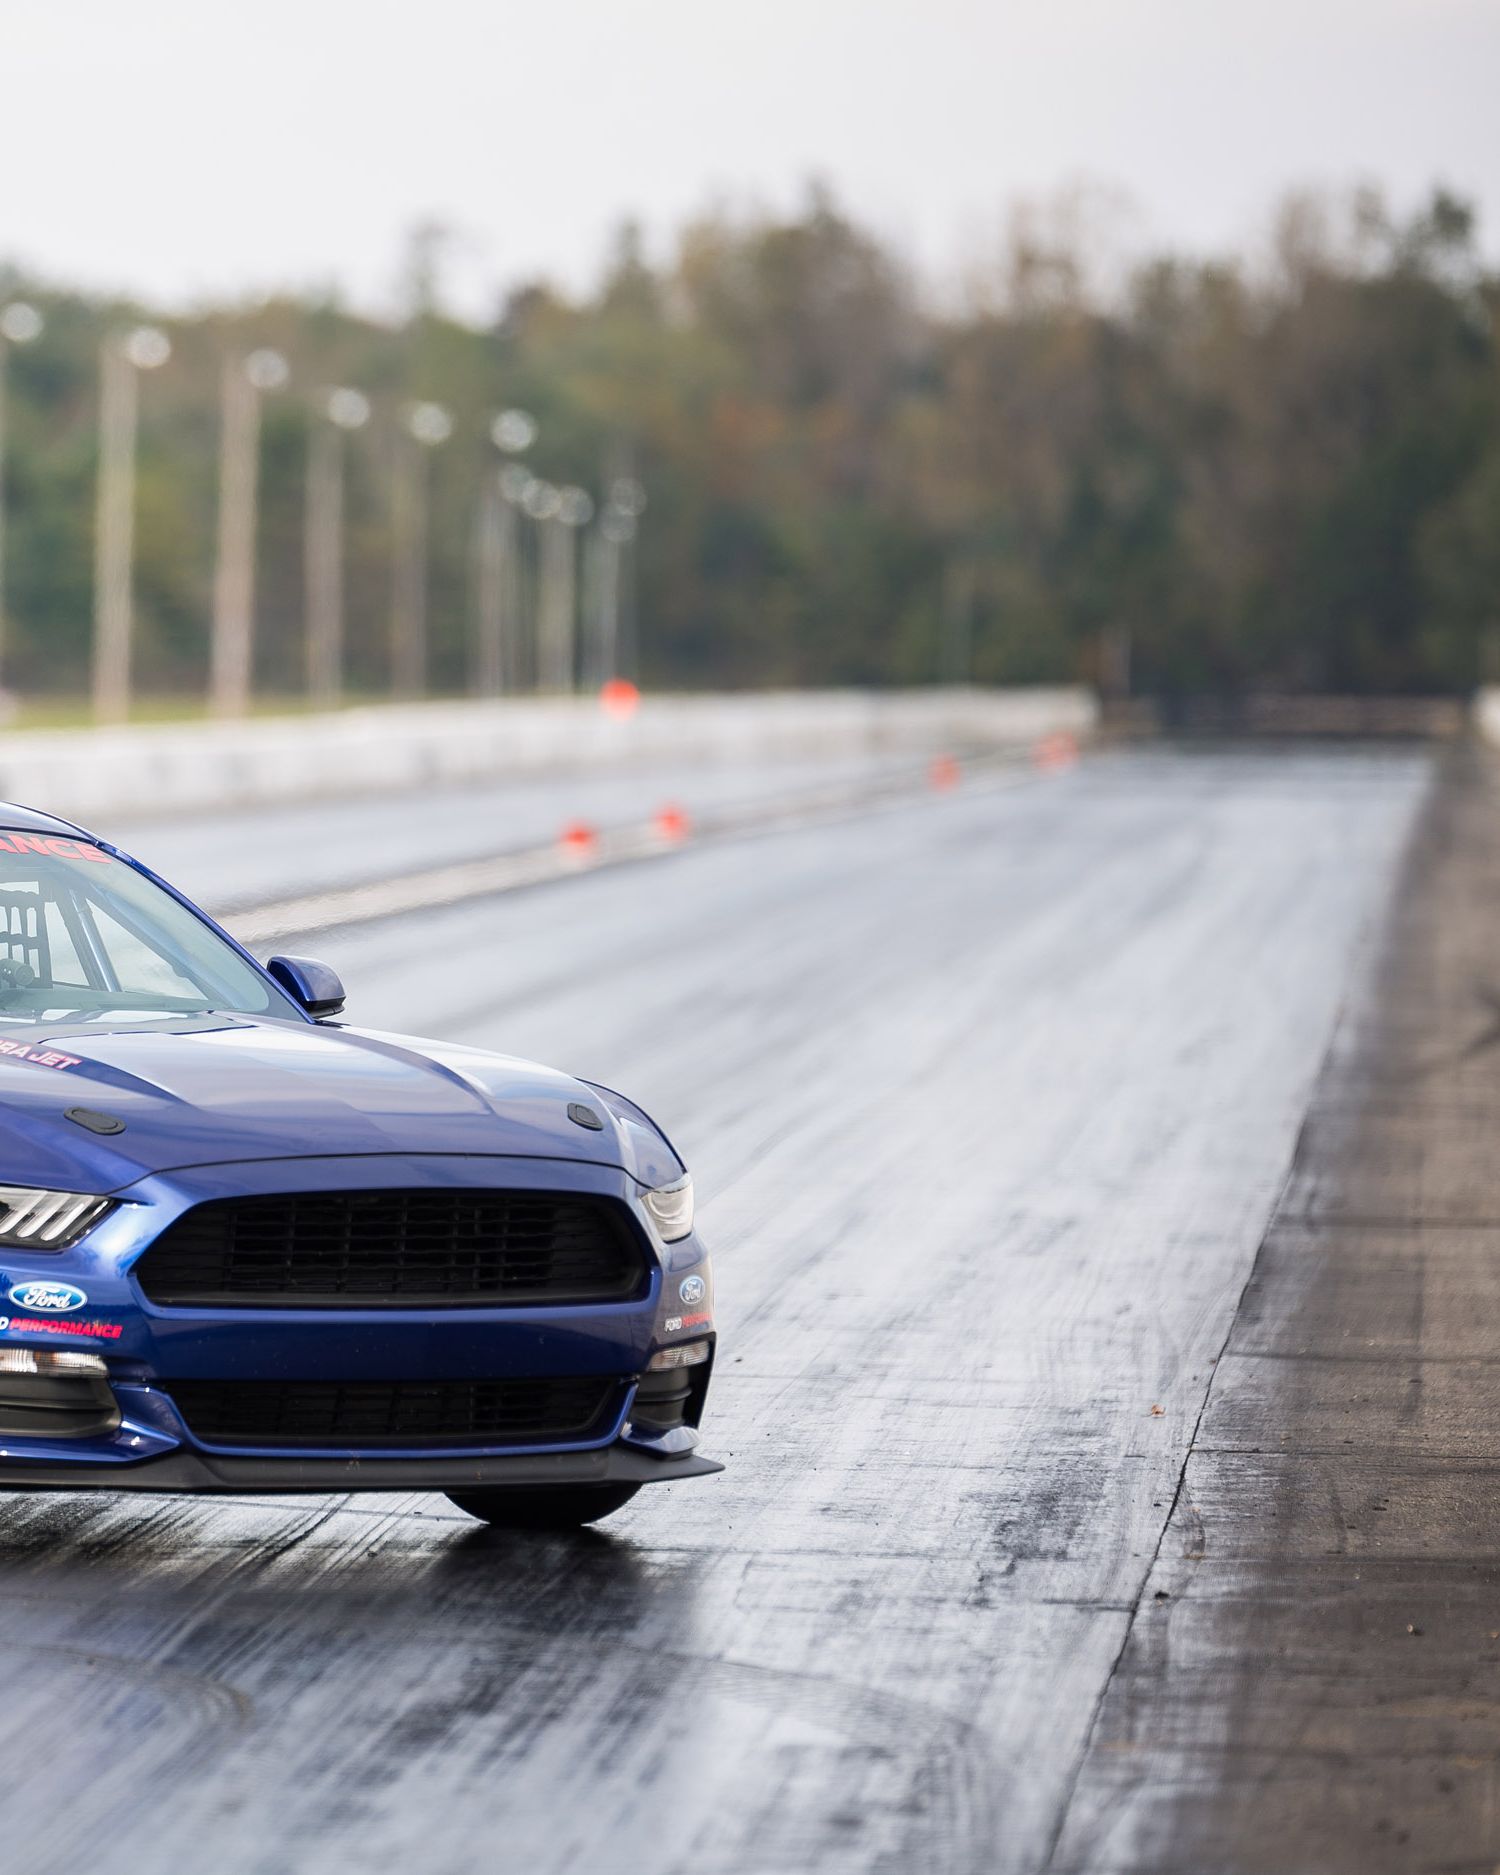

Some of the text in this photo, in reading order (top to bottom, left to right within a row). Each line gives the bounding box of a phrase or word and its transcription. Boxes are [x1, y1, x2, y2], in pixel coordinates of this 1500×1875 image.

[27, 1051, 82, 1070] JET
[23, 1286, 70, 1309] Ford
[9, 1318, 123, 1339] PERFORMANCE
